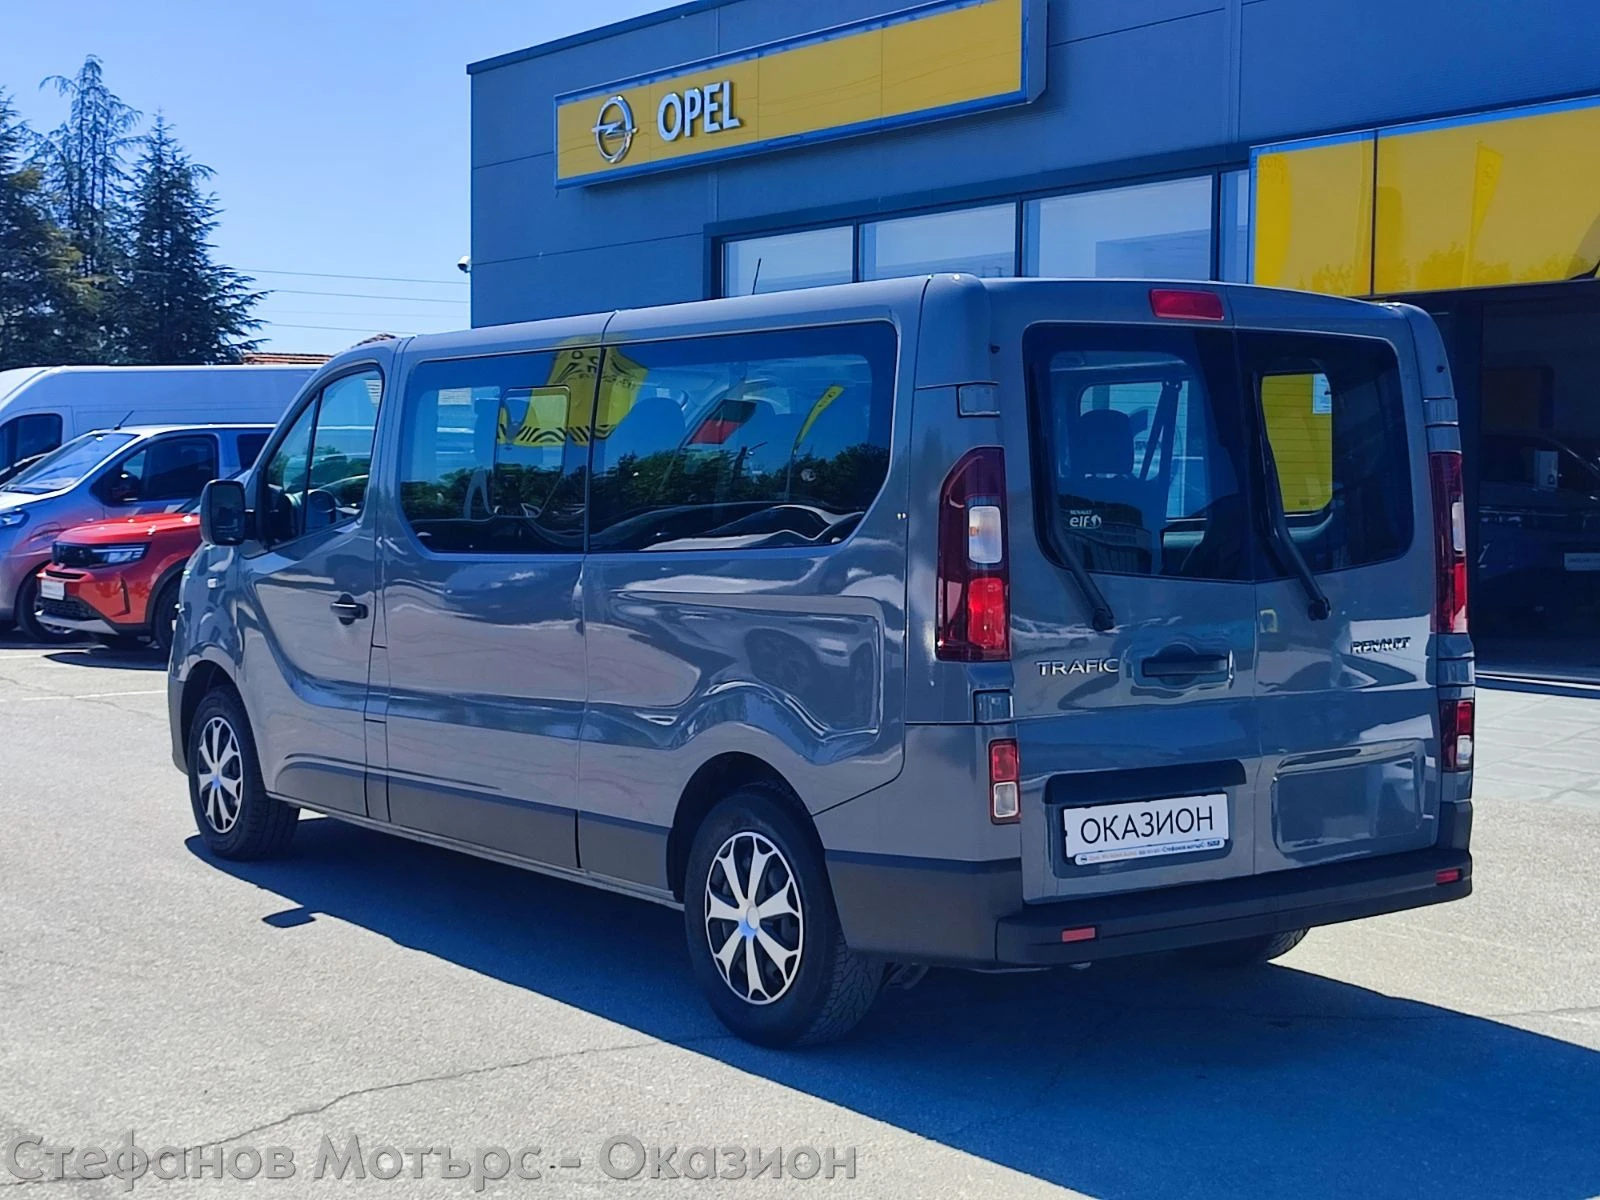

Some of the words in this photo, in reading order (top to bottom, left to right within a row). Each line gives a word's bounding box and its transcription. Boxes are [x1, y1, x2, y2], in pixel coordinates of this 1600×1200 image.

[657, 80, 741, 142] OPEL
[1035, 658, 1119, 676] TRAFIC
[1080, 805, 1213, 844] ОКАЗИОН
